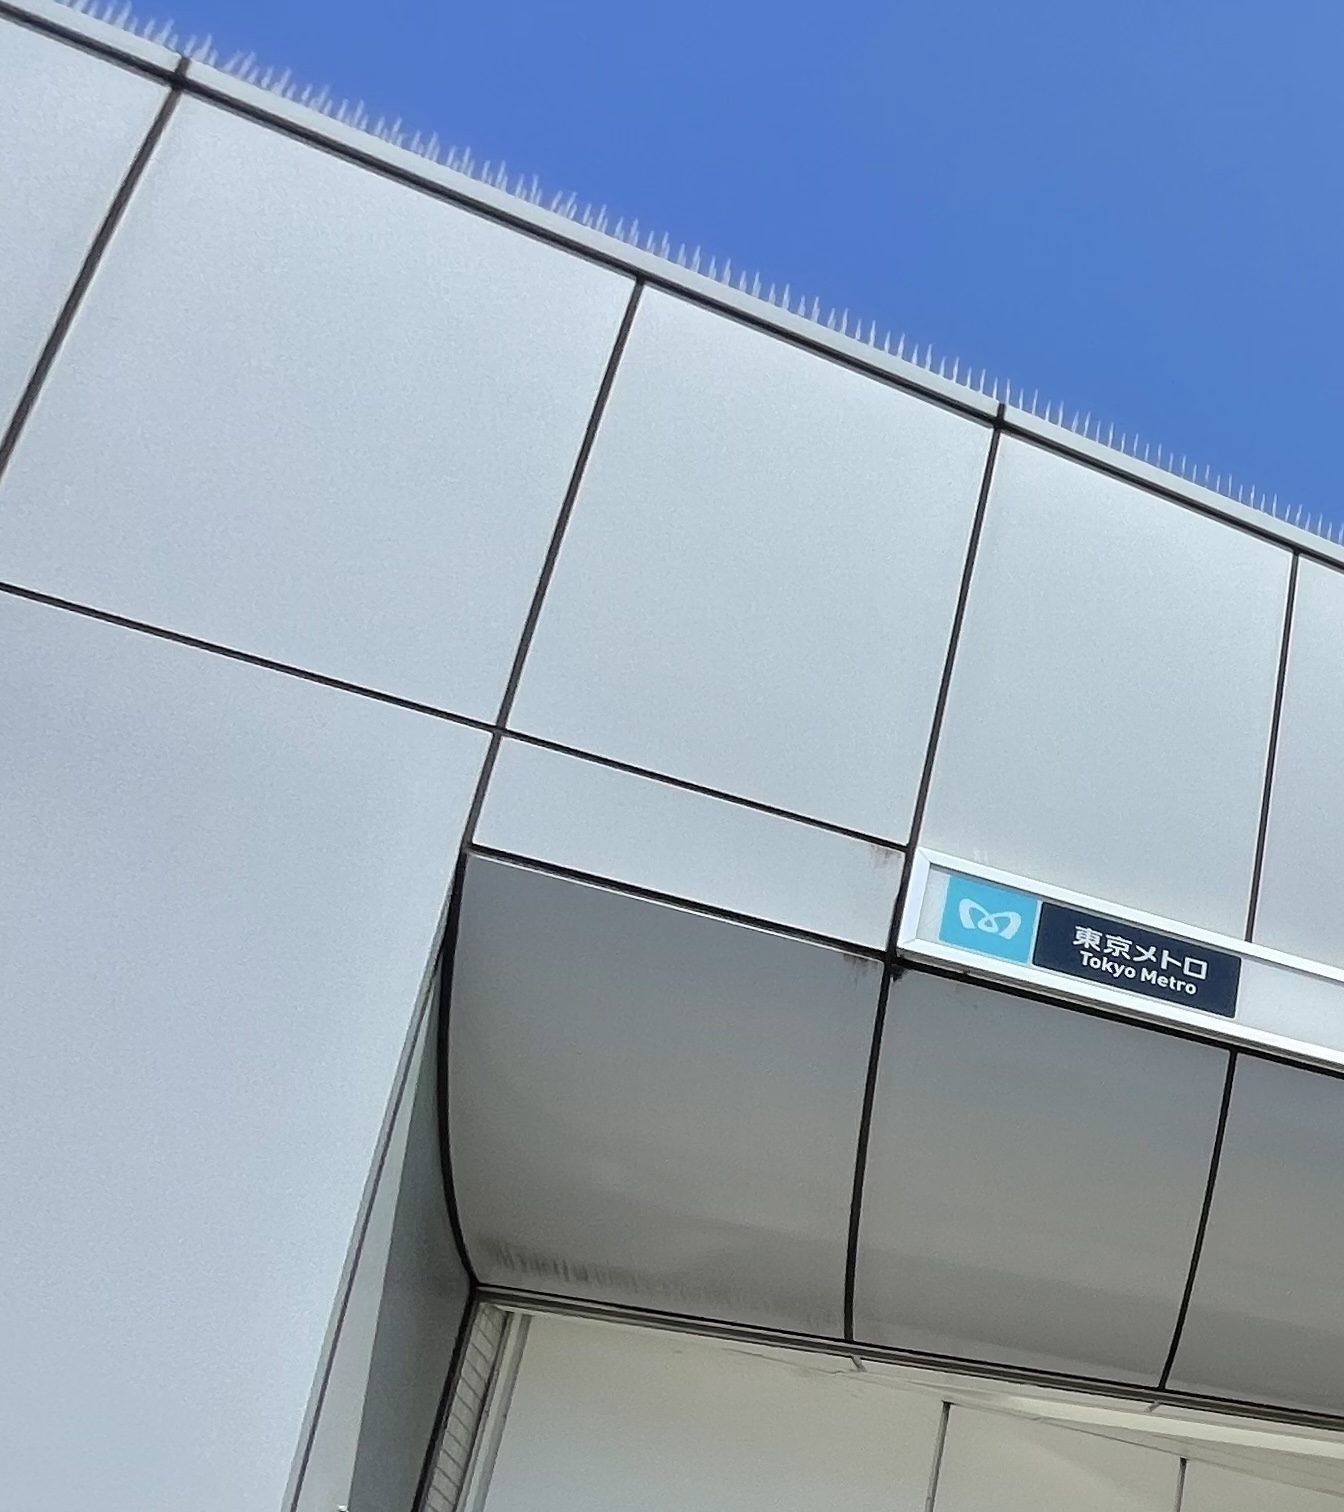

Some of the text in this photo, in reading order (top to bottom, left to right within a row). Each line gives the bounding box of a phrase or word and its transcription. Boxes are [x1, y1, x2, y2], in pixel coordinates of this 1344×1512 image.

[1072, 925, 1208, 980] 東京メトロ
[1079, 950, 1197, 995] Tokyo Metro
